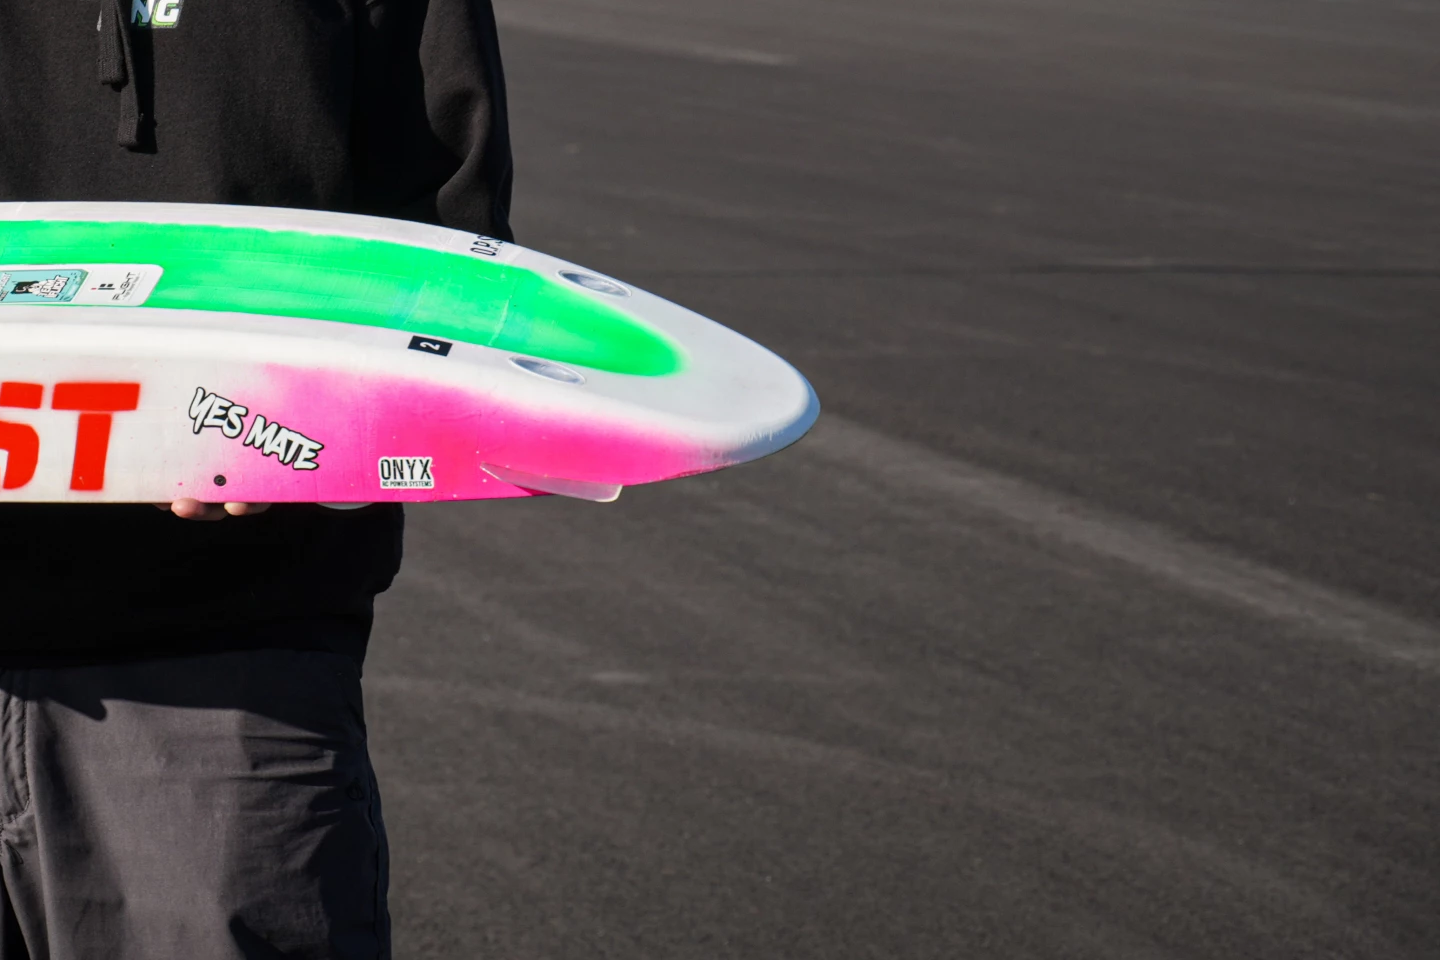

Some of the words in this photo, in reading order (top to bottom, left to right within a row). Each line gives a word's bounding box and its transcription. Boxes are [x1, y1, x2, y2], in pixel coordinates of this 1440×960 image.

[188, 386, 249, 439] YES
[242, 414, 325, 471] MATE
[380, 459, 431, 480] ONYX
